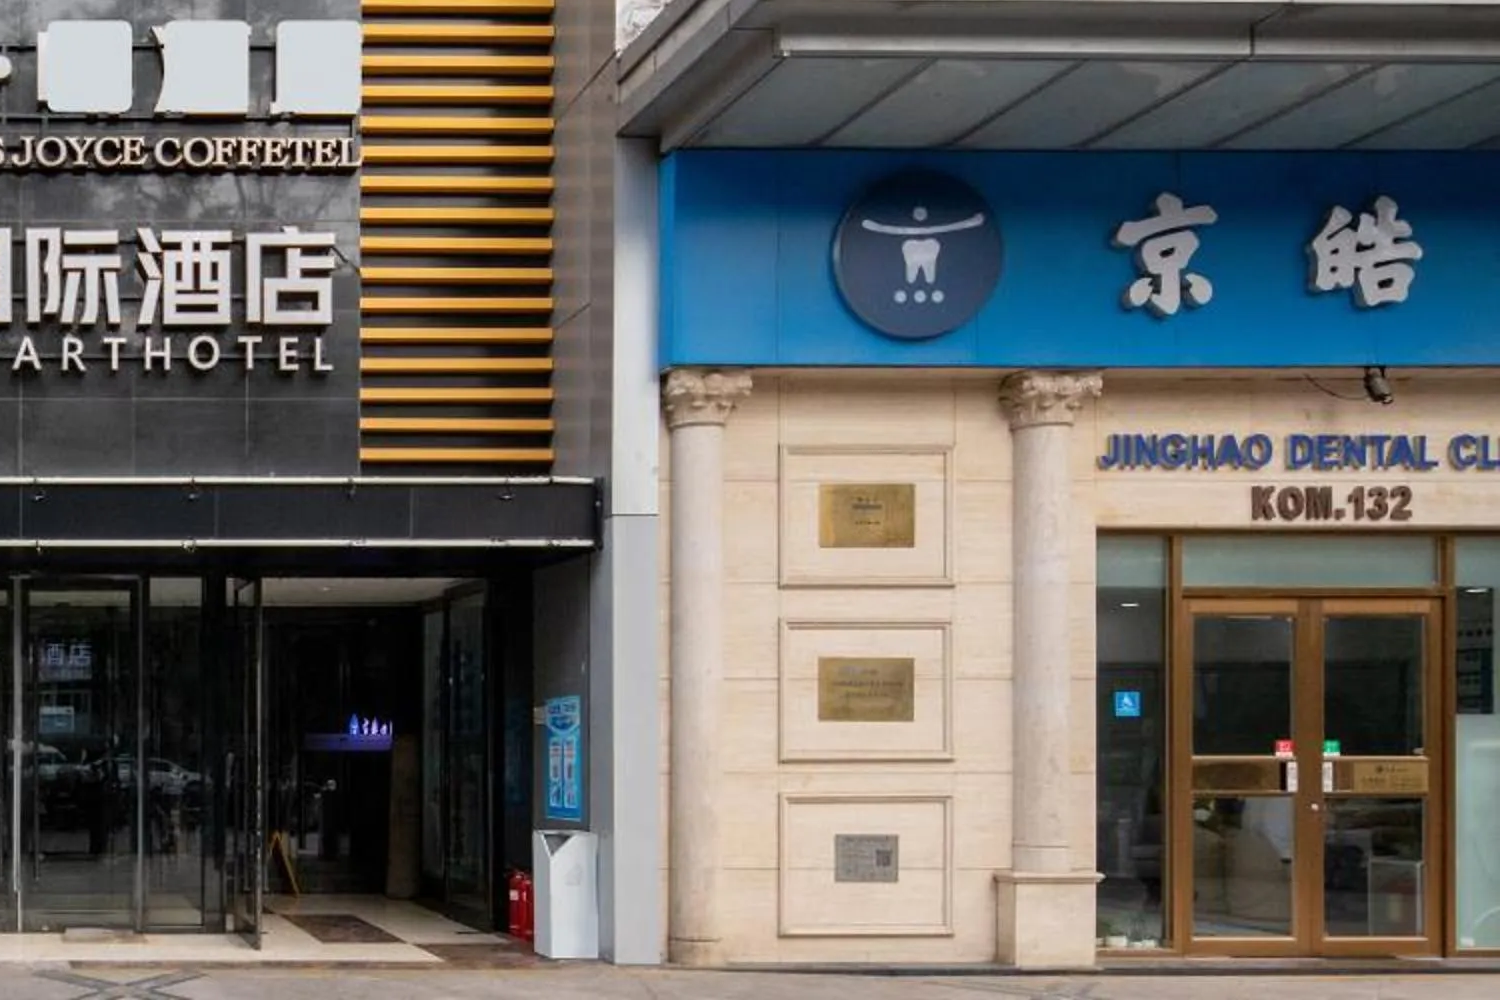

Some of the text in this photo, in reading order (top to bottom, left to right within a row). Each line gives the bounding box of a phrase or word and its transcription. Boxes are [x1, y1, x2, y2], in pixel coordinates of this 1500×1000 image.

[11, 135, 149, 167] JOYCE
[154, 135, 363, 168] COFFETEL
[1111, 191, 1424, 316] 京皓
[1098, 433, 1274, 471] JINGHAO
[1285, 433, 1439, 472] DENTAL
